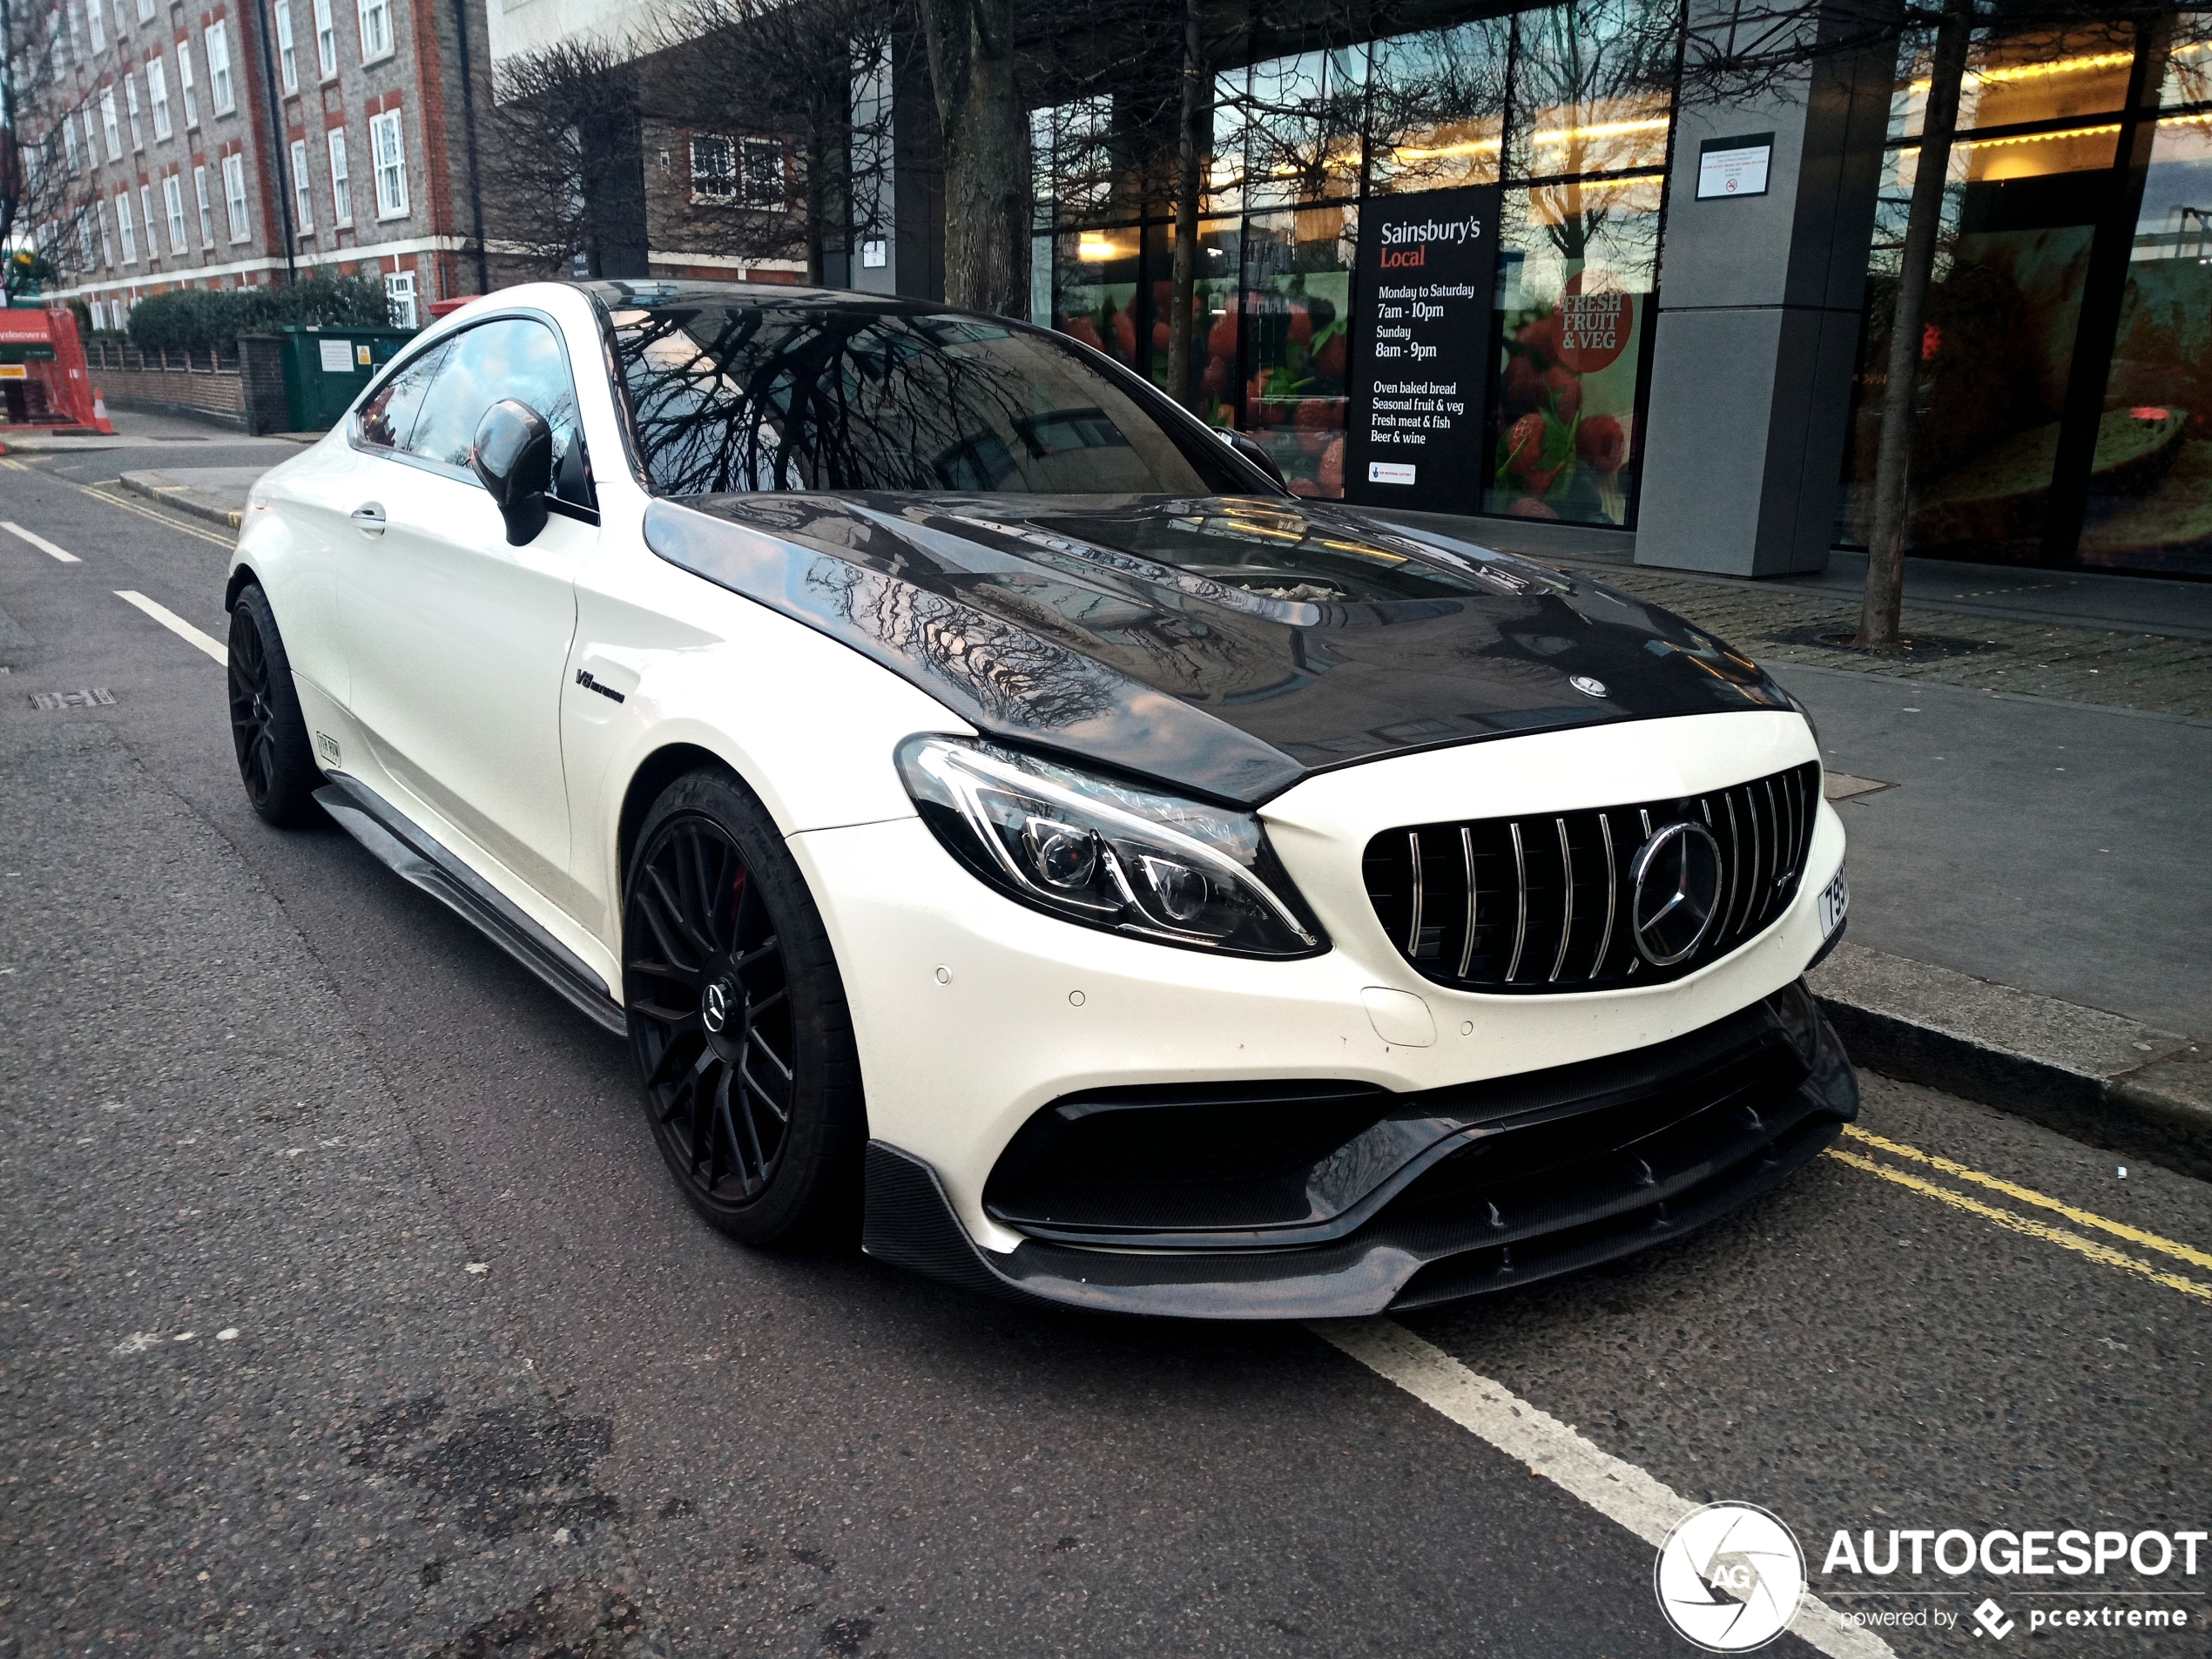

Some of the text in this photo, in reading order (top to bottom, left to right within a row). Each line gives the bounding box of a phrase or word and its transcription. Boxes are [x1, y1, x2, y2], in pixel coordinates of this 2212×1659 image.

[1381, 215, 1480, 244] Sainsbury's
[1380, 245, 1426, 268] Local
[1379, 283, 1474, 300] Monday to Saturday
[1378, 303, 1402, 319] 7am
[1412, 301, 1444, 321] 10pm
[1563, 293, 1622, 313] FRESH
[1562, 313, 1620, 331] FRUIT
[1376, 325, 1411, 341] Sunday
[1562, 331, 1616, 349] & VEG
[1376, 341, 1401, 357] 8am
[1411, 341, 1437, 361] 9pm
[1373, 381, 1456, 395] Oven baked bread
[1372, 397, 1464, 415] Seasonal fruit & veg
[1372, 414, 1451, 428] Fresh meat & fish
[1371, 429, 1426, 444] Beer & wine
[576, 668, 594, 689] V8
[1825, 860, 1845, 927] 799
